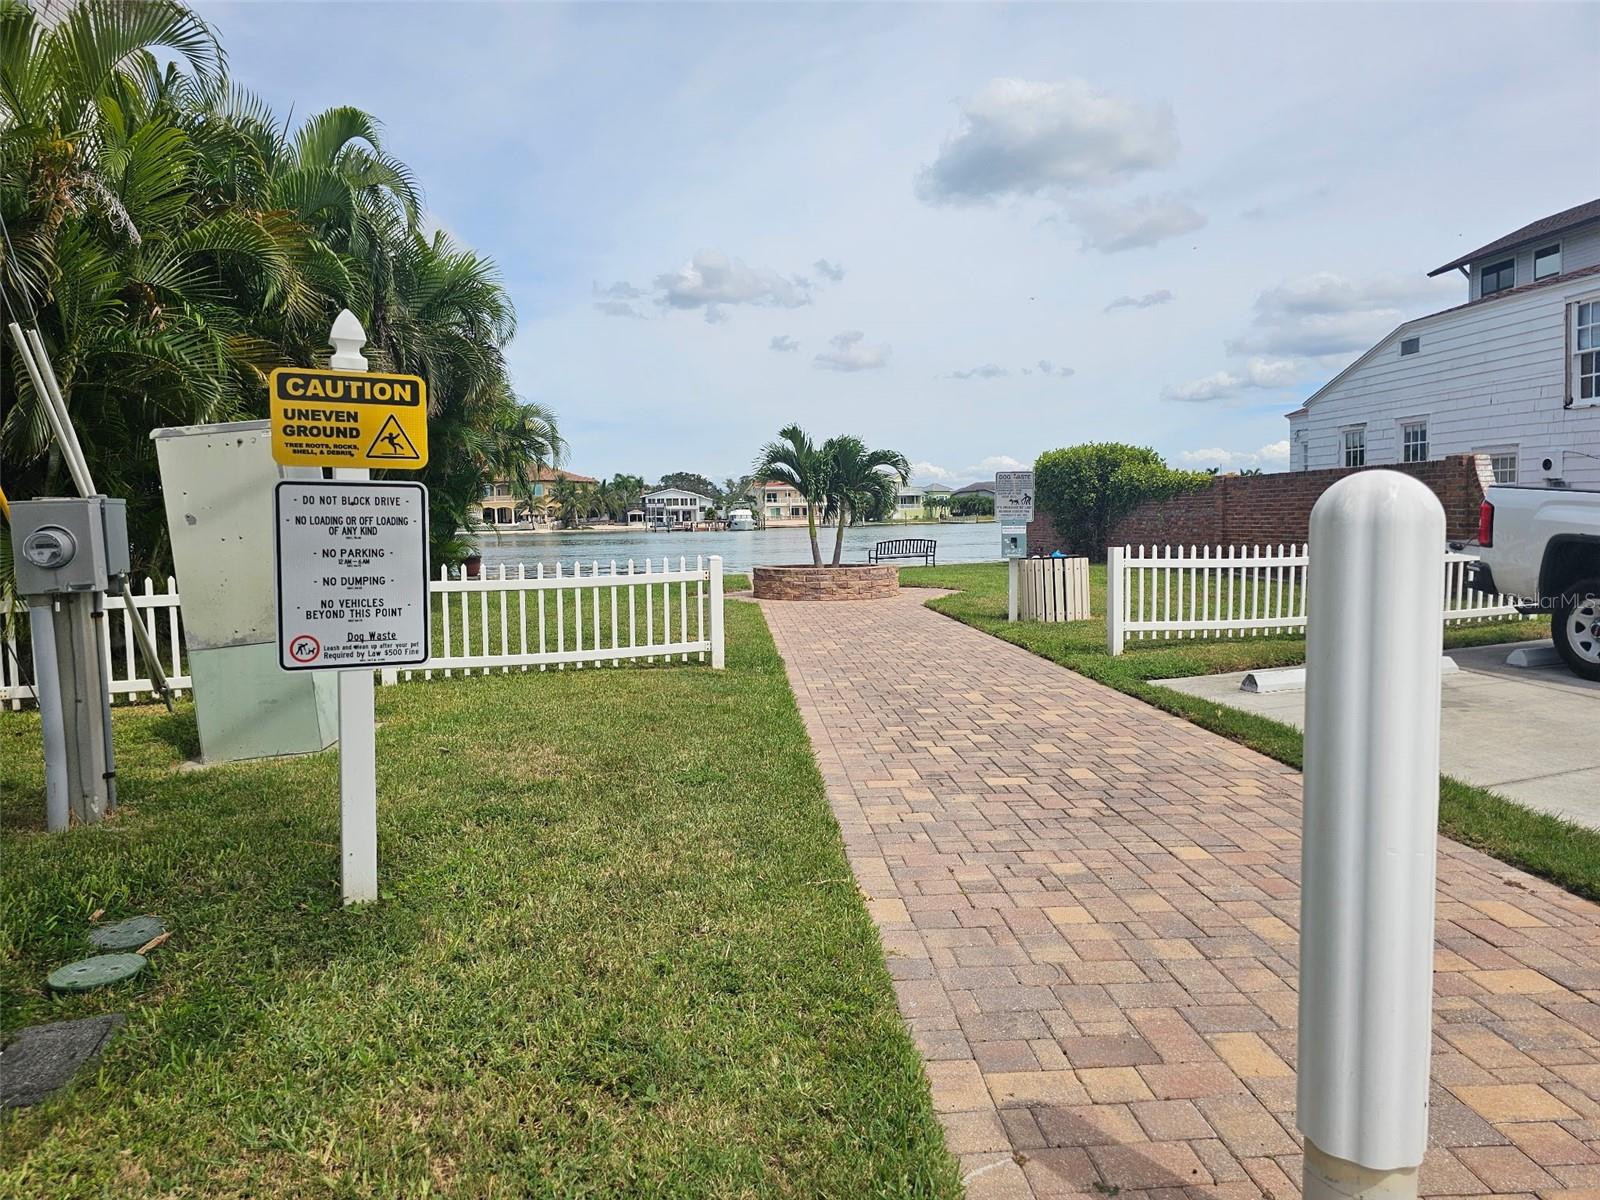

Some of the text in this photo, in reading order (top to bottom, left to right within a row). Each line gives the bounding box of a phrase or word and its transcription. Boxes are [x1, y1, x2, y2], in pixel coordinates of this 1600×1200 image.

[286, 378, 412, 401] CAUTION
[283, 408, 358, 423] UNEVEN
[282, 425, 360, 439] GROUND
[303, 496, 400, 506] DO NOT BLOCK DRIVE
[295, 516, 408, 526] NO LOADING OR OFF LOADING
[329, 527, 378, 535] OF ANY KIND
[322, 549, 385, 558] NO PARKING
[323, 576, 385, 586] NO DUMPING
[321, 599, 384, 608] NO VEHICLES
[306, 608, 402, 619] BEYOND THIS POINT
[347, 631, 397, 643] Dog Waste
[324, 652, 354, 660] Required
[357, 651, 365, 659] by
